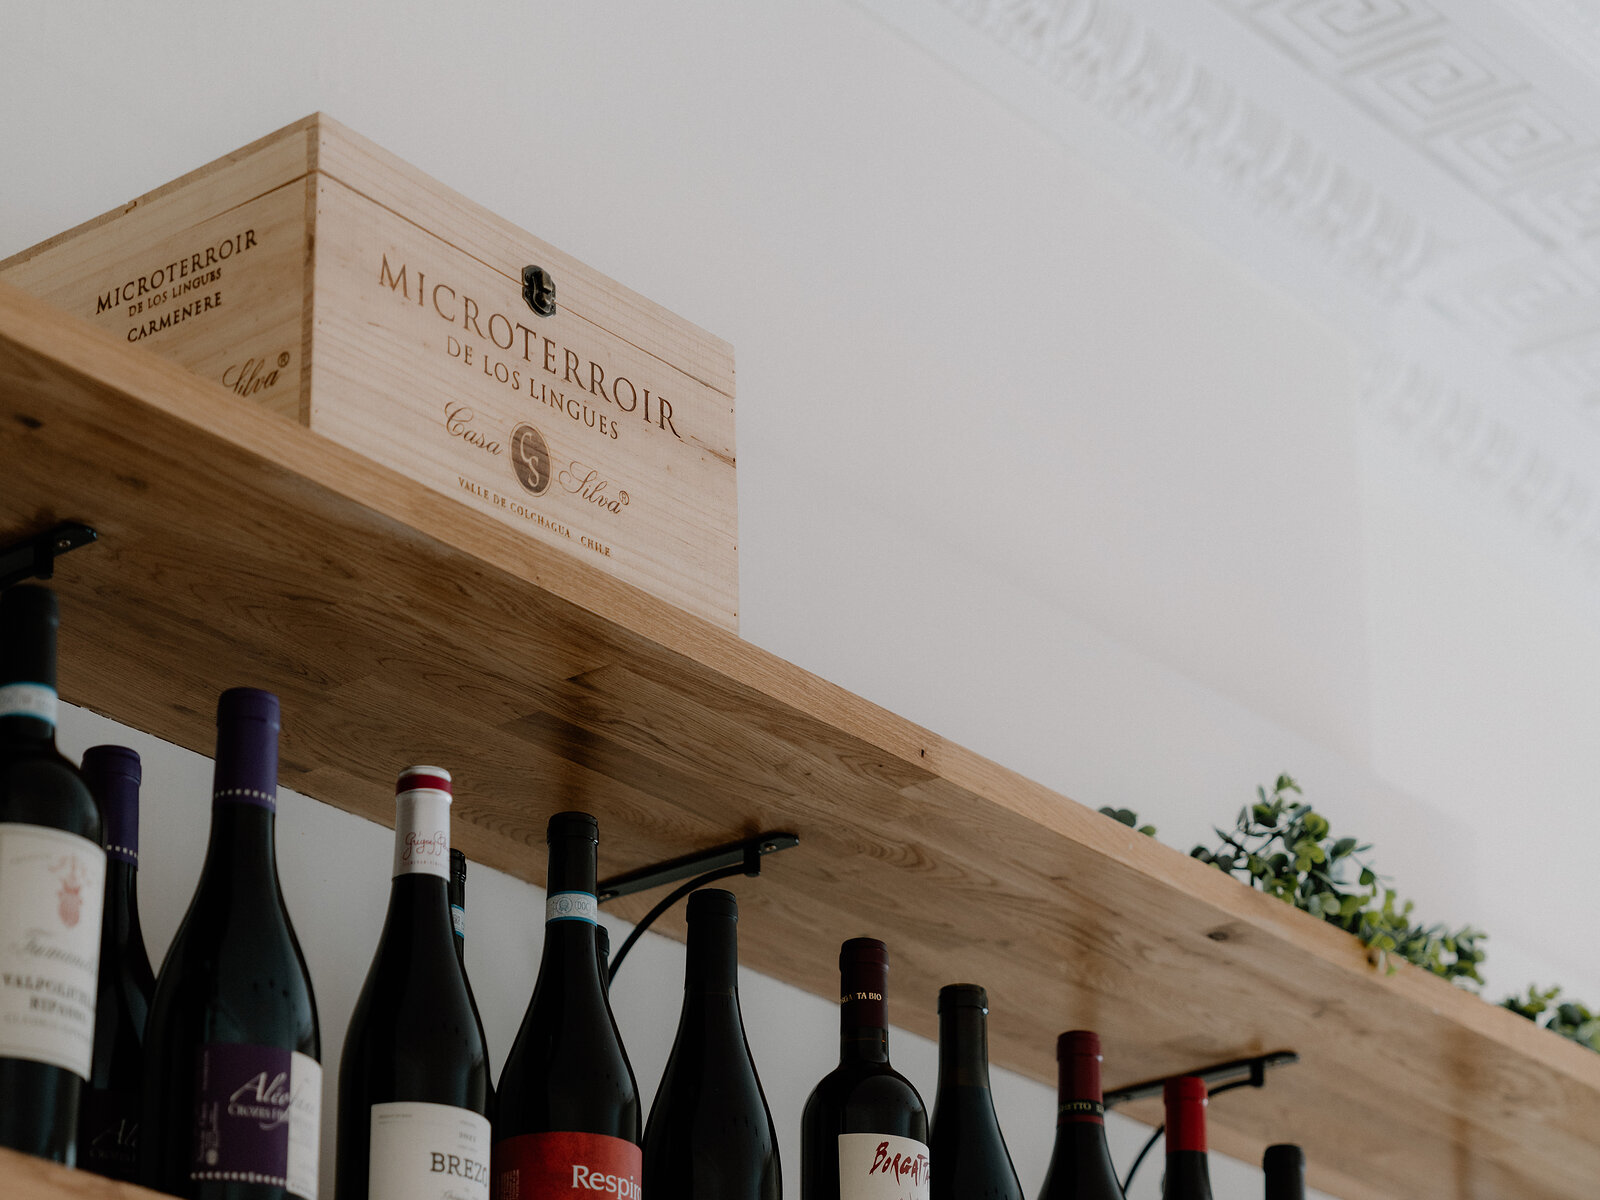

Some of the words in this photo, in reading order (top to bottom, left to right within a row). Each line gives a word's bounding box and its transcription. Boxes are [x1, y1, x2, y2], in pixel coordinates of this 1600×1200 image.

[95, 229, 258, 315] MICROTERROIR
[128, 301, 143, 317] DE
[147, 291, 168, 309] LOS
[172, 267, 222, 299] LINGUES
[127, 292, 222, 342] CARMENERE
[379, 253, 681, 438] MICROTERROIR
[447, 336, 473, 367] DE
[484, 355, 520, 391] LOS
[530, 378, 619, 440] LINGUES
[444, 401, 504, 456] Casa
[458, 476, 489, 500] VALLE
[493, 494, 506, 509] DE
[510, 502, 571, 538] COLCHAGUA
[580, 535, 611, 557] CHILE
[868, 992, 882, 1001] BIO
